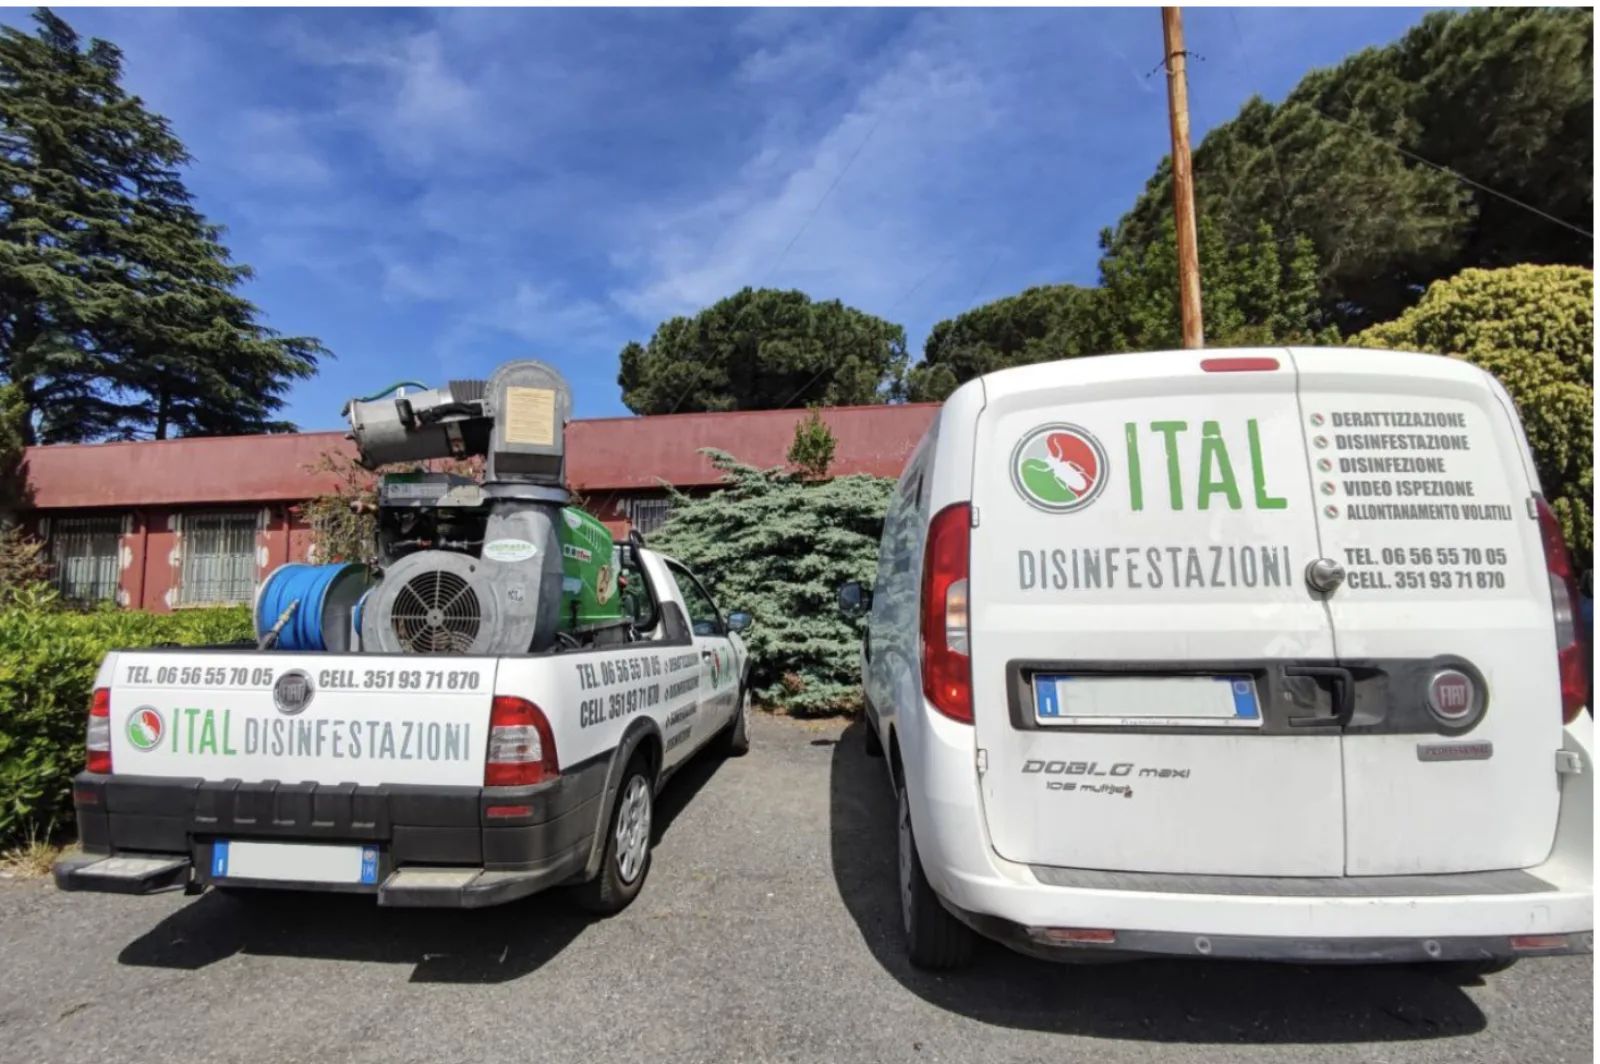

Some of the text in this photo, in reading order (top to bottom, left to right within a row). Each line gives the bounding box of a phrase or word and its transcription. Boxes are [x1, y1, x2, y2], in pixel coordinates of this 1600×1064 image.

[1331, 412, 1467, 428] DERATTIZZAZIONE
[1335, 434, 1471, 450] DISINFESTAZIONE
[1125, 418, 1288, 511] ITAL
[1338, 457, 1446, 473] DISINFEZIONE
[1342, 480, 1475, 496] VIDEO ISPEZIONE
[1347, 504, 1513, 520] ALLONTANAMENTO VOLATILI
[1344, 548, 1507, 565] TEL. 06 56 55 70 05
[1018, 546, 1292, 590] DISINFESTAZIONI
[1347, 572, 1506, 589] CELL. 351 93 71 870
[126, 666, 274, 686] TEL. 06 56 55 70 05
[318, 669, 480, 690] CELL. 351 93 71 870
[575, 662, 601, 691] TEL.
[600, 660, 616, 686] 06
[615, 659, 630, 683] 56
[628, 658, 642, 681] 55
[1439, 685, 1466, 707] FIAT
[580, 697, 607, 729] CELL.
[608, 692, 625, 720] 351
[626, 688, 637, 714] 93
[172, 707, 237, 755] ITAL
[244, 717, 471, 761] DISINFESTAZIONI
[1138, 768, 1191, 779] maxi
[1046, 781, 1077, 791] 105
